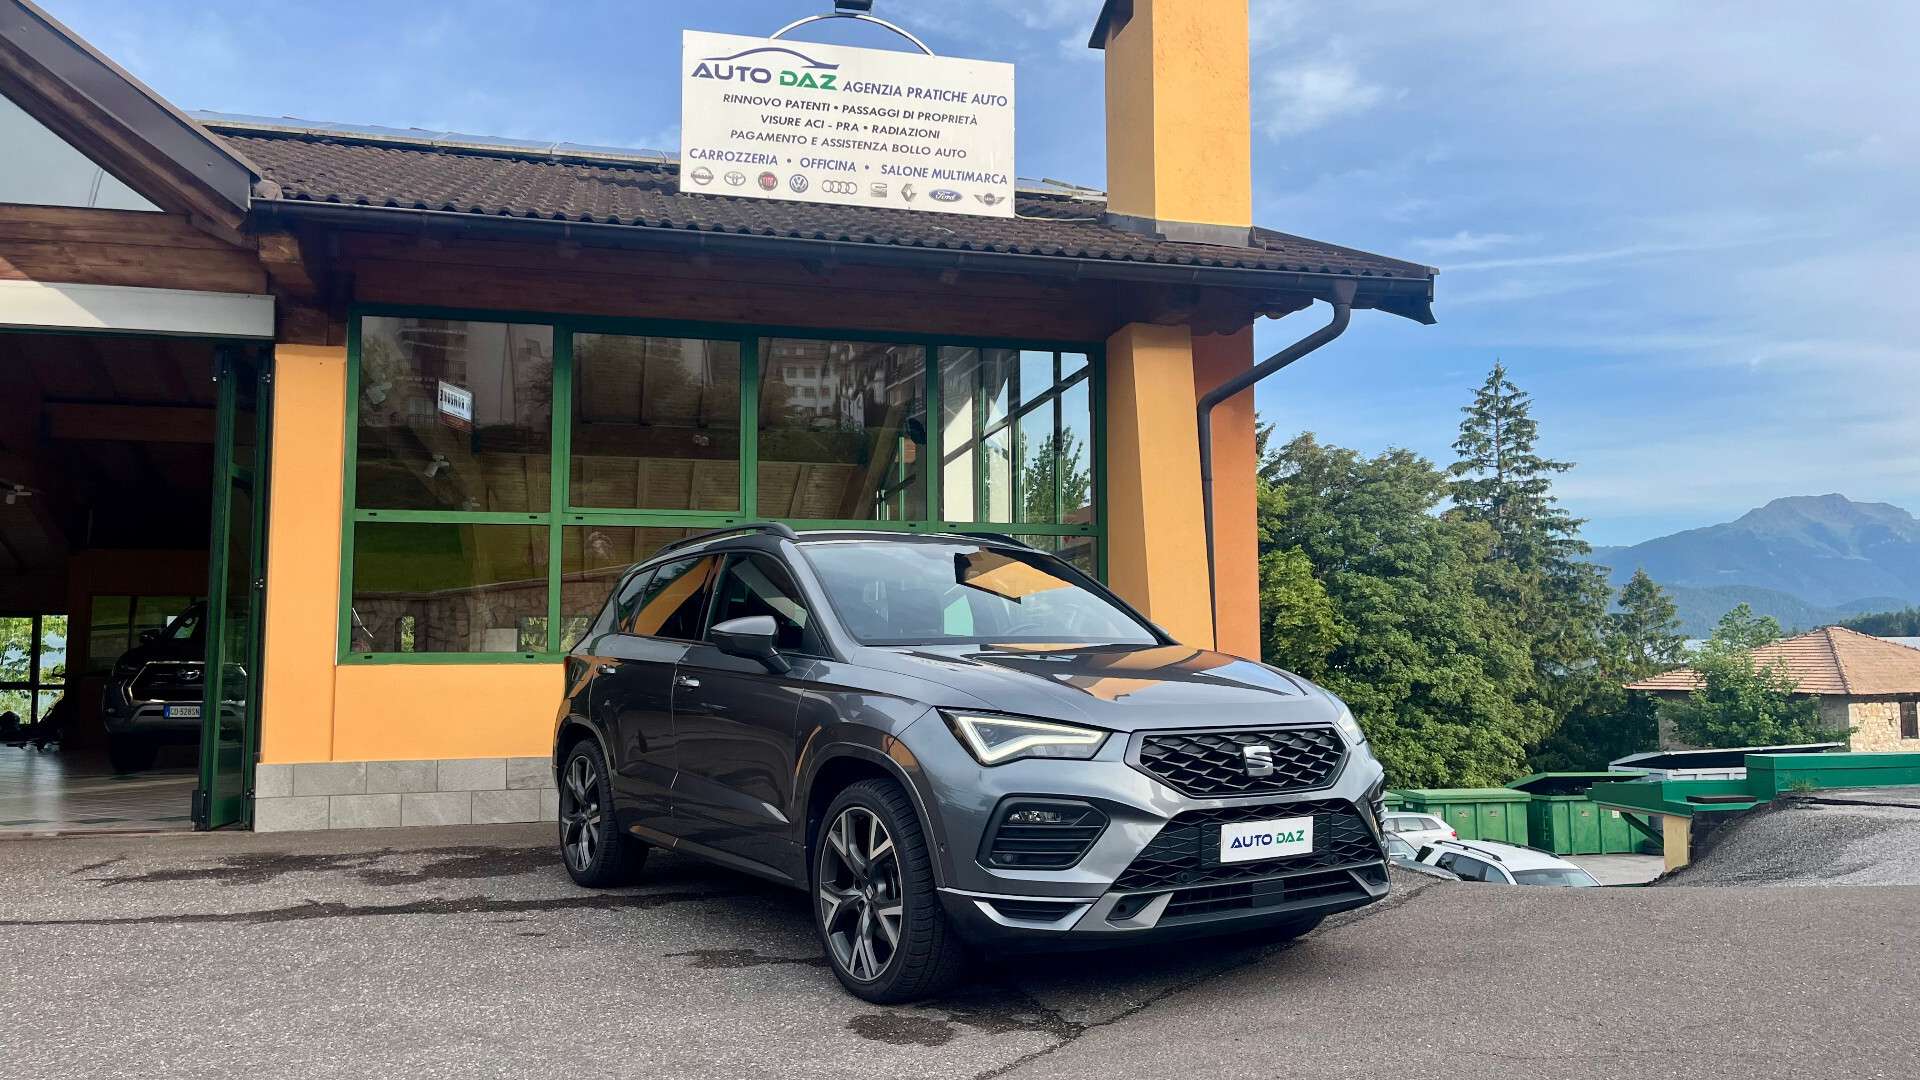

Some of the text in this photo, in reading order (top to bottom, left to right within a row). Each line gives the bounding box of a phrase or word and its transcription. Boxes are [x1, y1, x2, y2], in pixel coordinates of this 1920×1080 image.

[691, 62, 837, 91] AUTO DAZ
[842, 80, 1008, 107] AGENZIA PRATICHE AUTO
[723, 93, 978, 126] RINNOVO PATENTI PASSAGGI DI PROPRIETÀ
[761, 114, 802, 127] VISURE
[804, 118, 825, 129] ACI
[836, 121, 859, 132] PRA
[871, 124, 940, 139] RADIAZIONI
[730, 129, 967, 159] PAGAMENTO E ASSISTENZA BOLLO AUTO
[689, 148, 1008, 185] CARROZZERIA OFFICINA SALONE MULTIMARCA
[1230, 829, 1305, 849] AUTO DAZ
